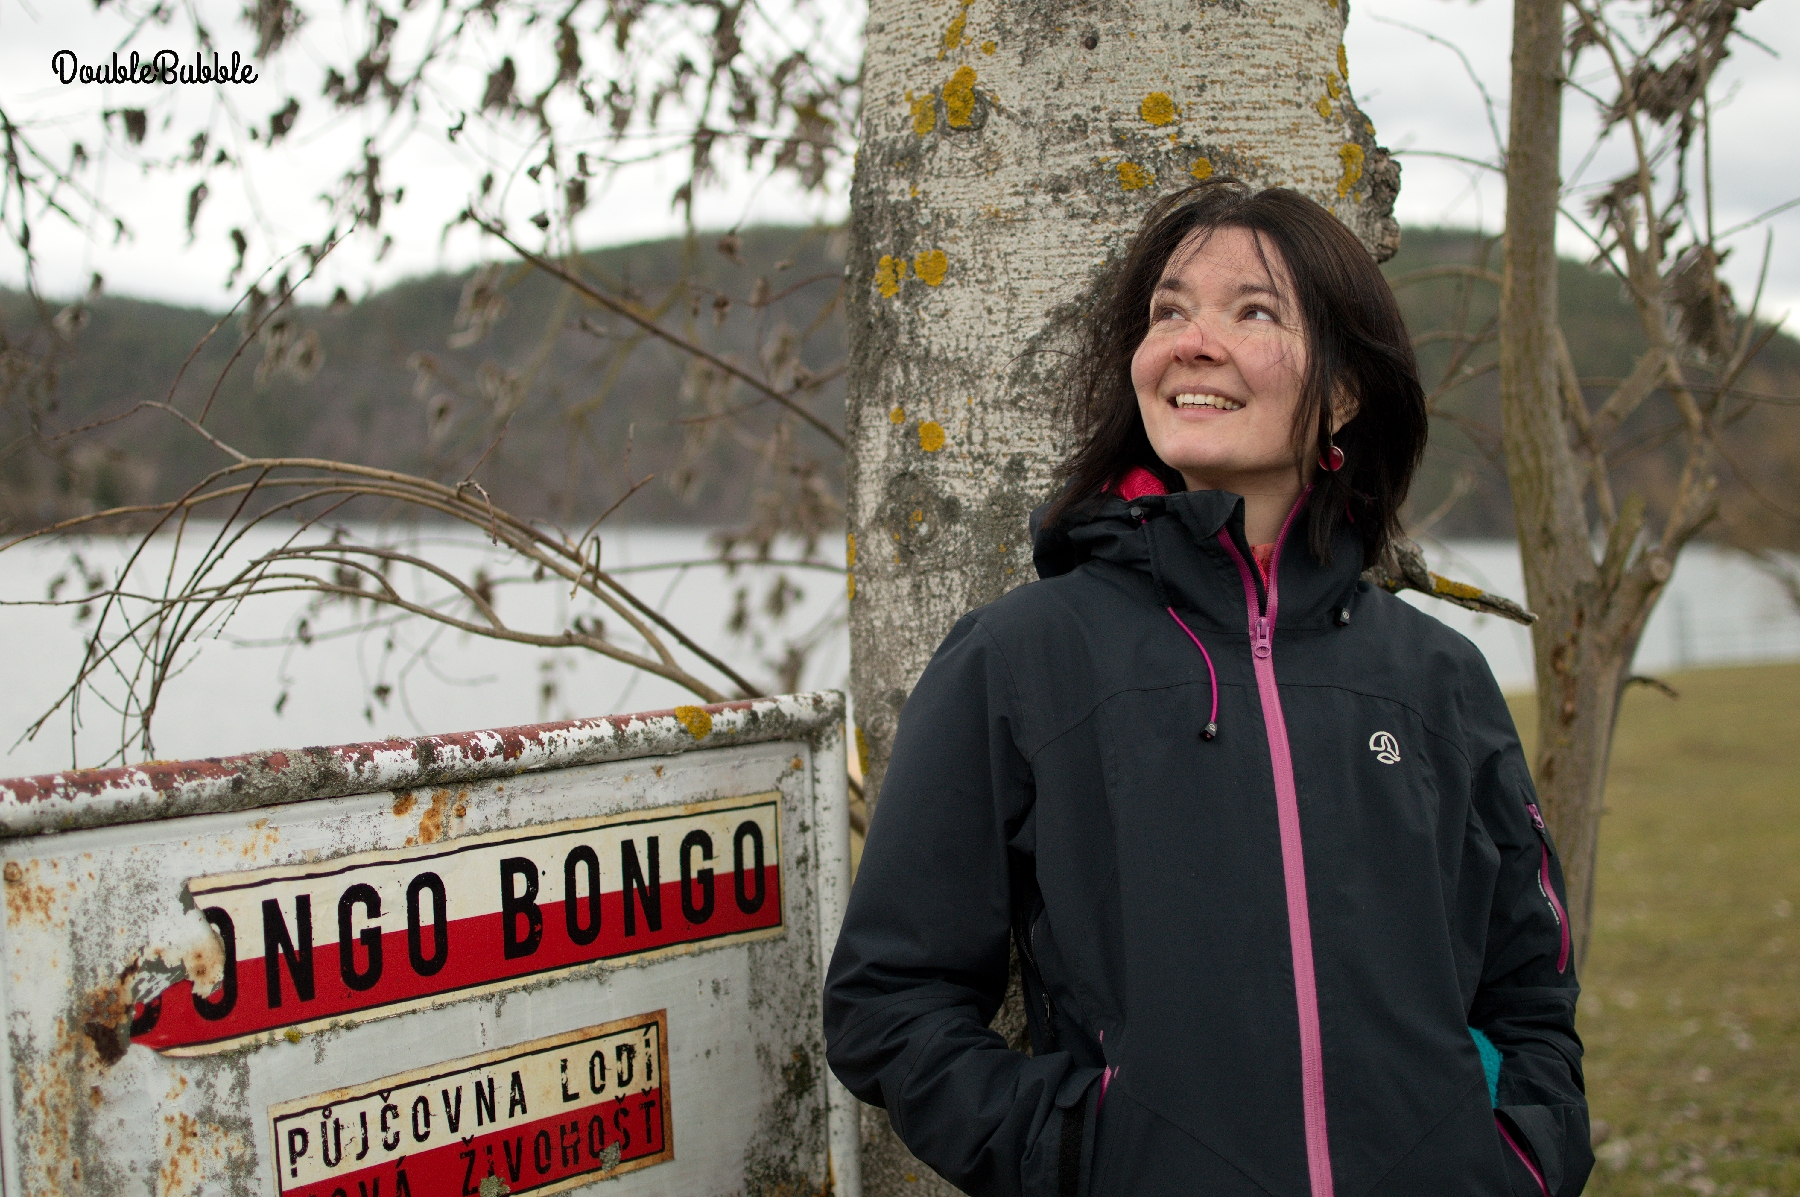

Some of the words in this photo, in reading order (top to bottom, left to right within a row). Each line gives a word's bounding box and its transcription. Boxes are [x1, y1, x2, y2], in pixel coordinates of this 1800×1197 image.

[130, 871, 448, 1037] ONGO
[502, 820, 766, 960] BONGO
[288, 1071, 528, 1177] PŮJČOVNA
[560, 1025, 653, 1103] LODÍ
